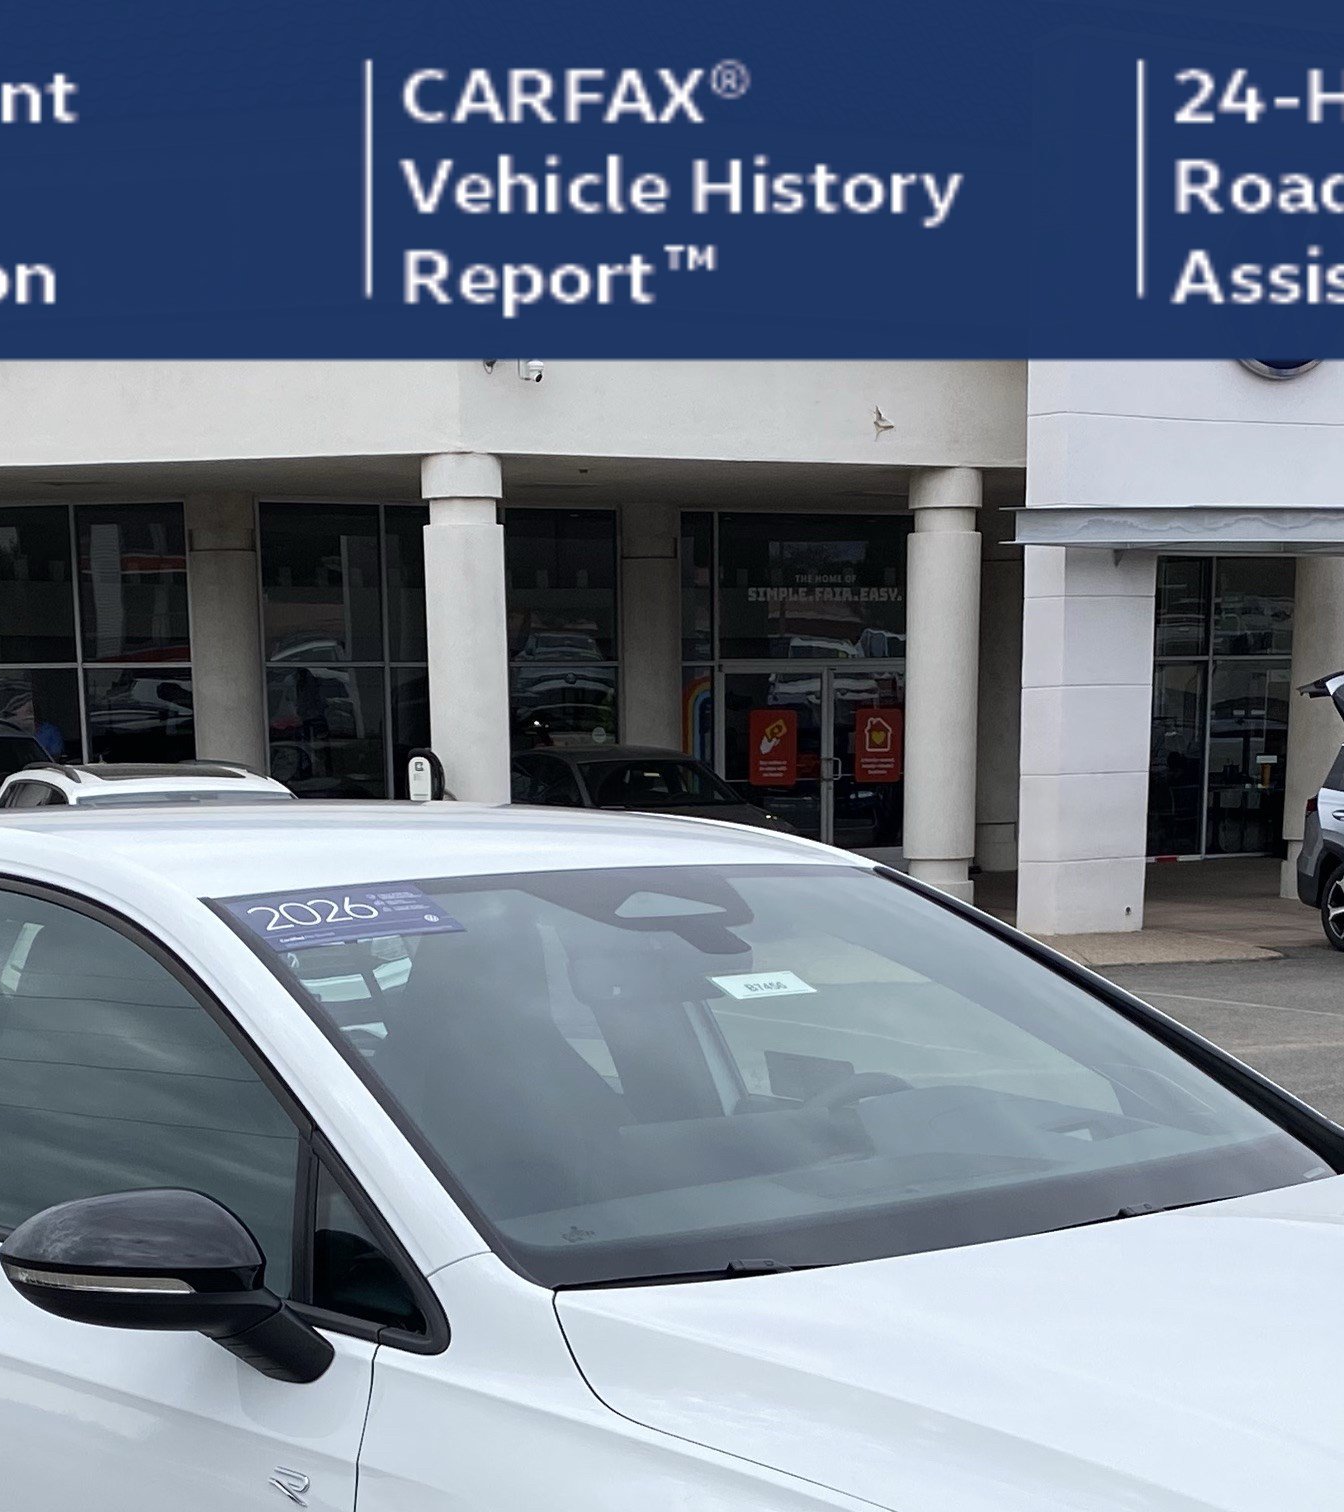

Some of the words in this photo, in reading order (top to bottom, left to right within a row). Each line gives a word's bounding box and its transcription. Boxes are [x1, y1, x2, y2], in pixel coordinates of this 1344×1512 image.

[795, 574, 812, 583] THE
[815, 574, 842, 583] HOME
[845, 574, 858, 583] OF
[246, 896, 380, 931] 2026
